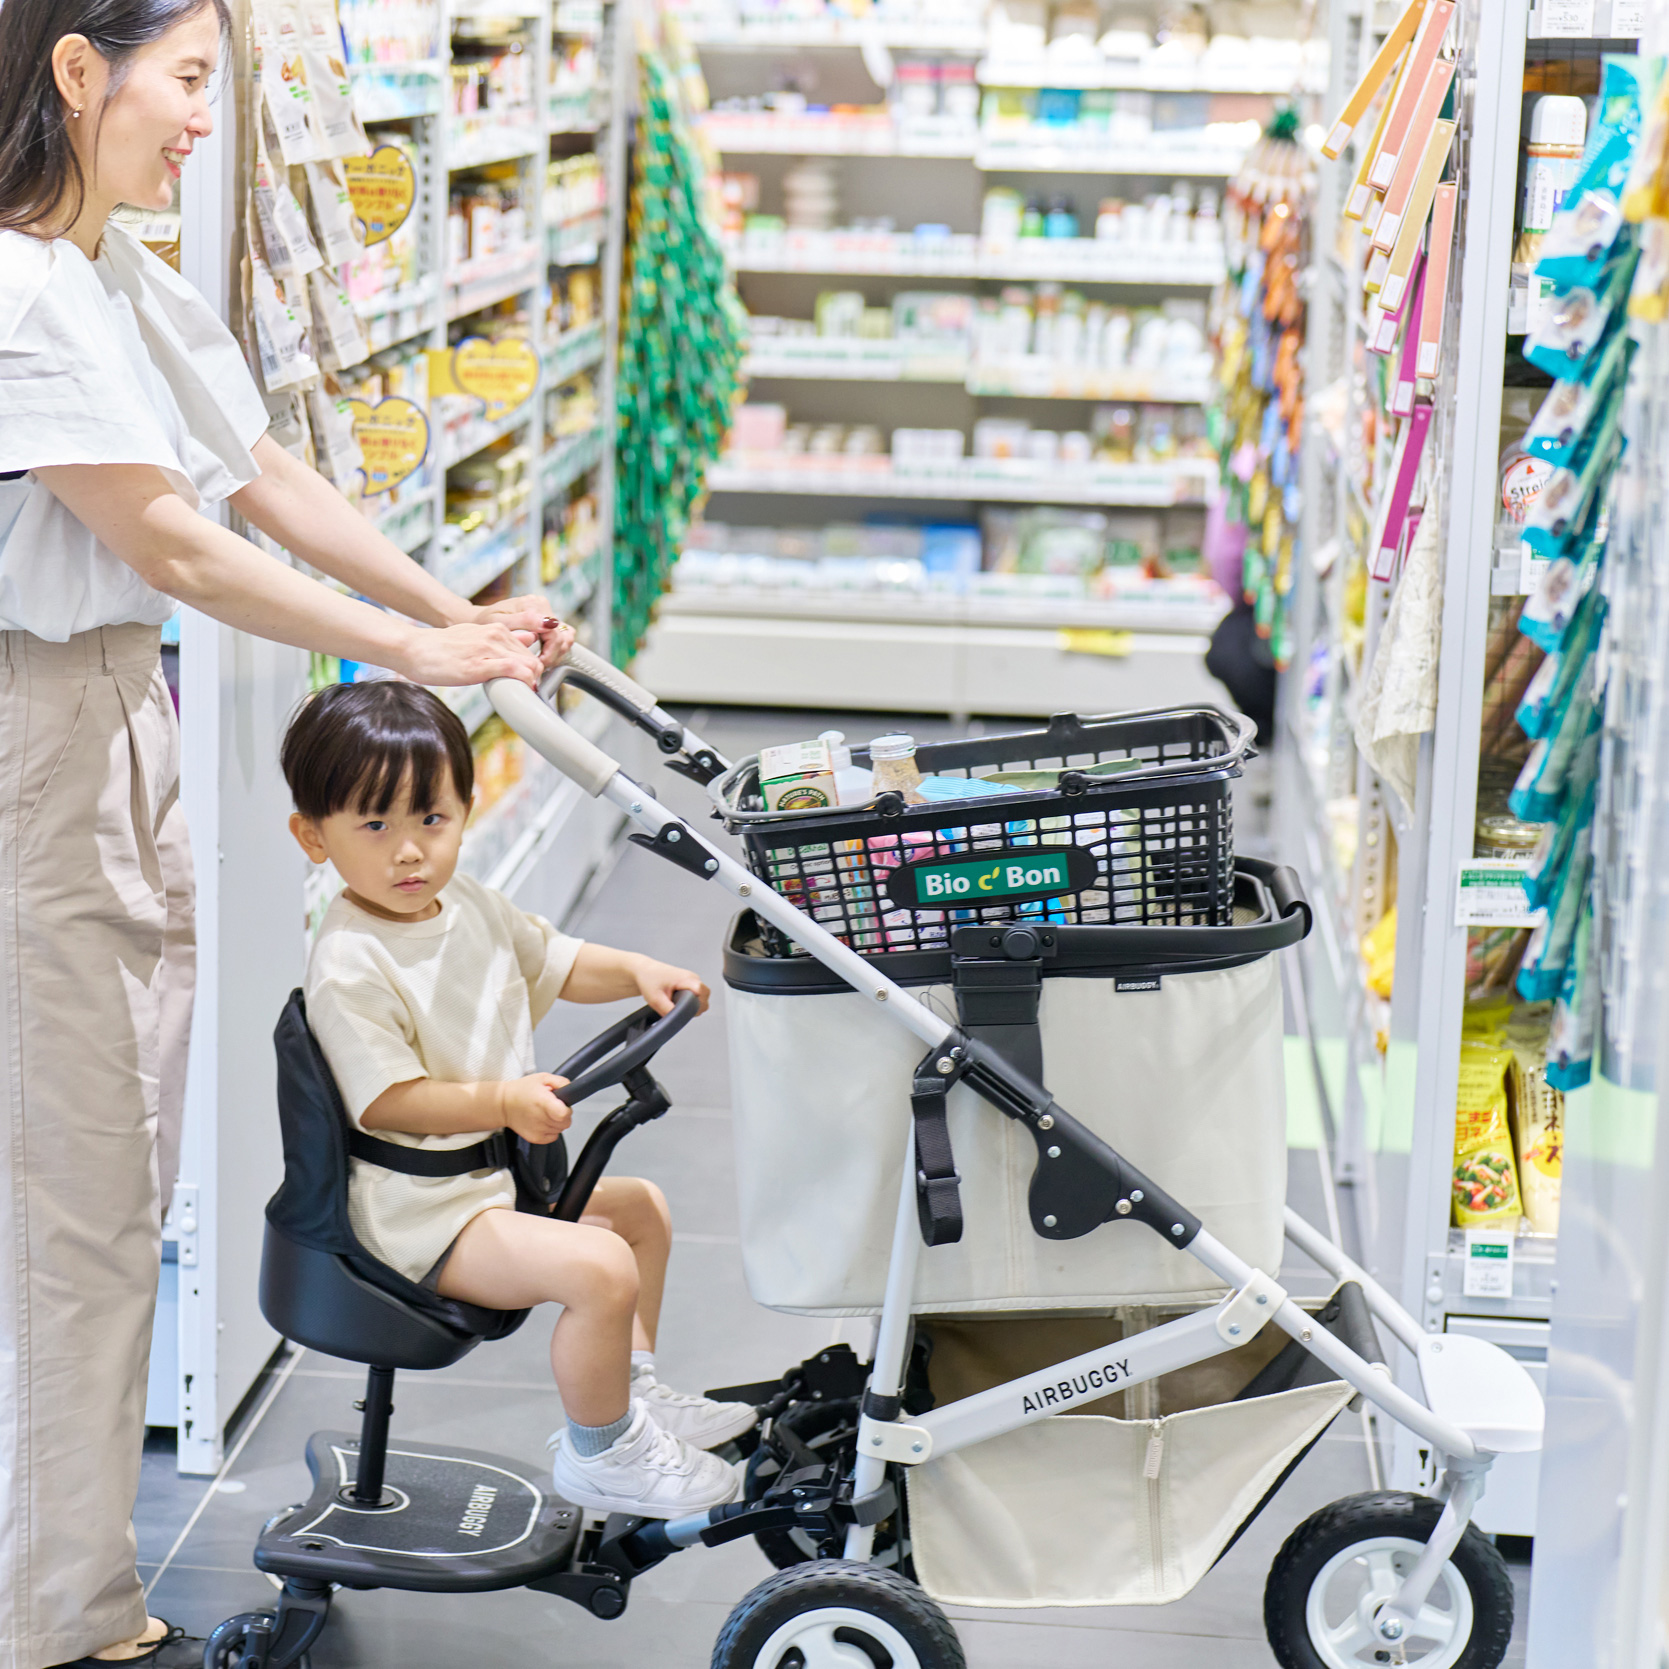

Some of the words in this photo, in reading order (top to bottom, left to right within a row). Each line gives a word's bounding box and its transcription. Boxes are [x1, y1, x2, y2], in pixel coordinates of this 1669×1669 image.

[925, 872, 971, 896] Bio
[1006, 866, 1061, 888] Bon
[1022, 1358, 1130, 1415] AIRBUGGY
[457, 1484, 499, 1537] AIRBUGGY
